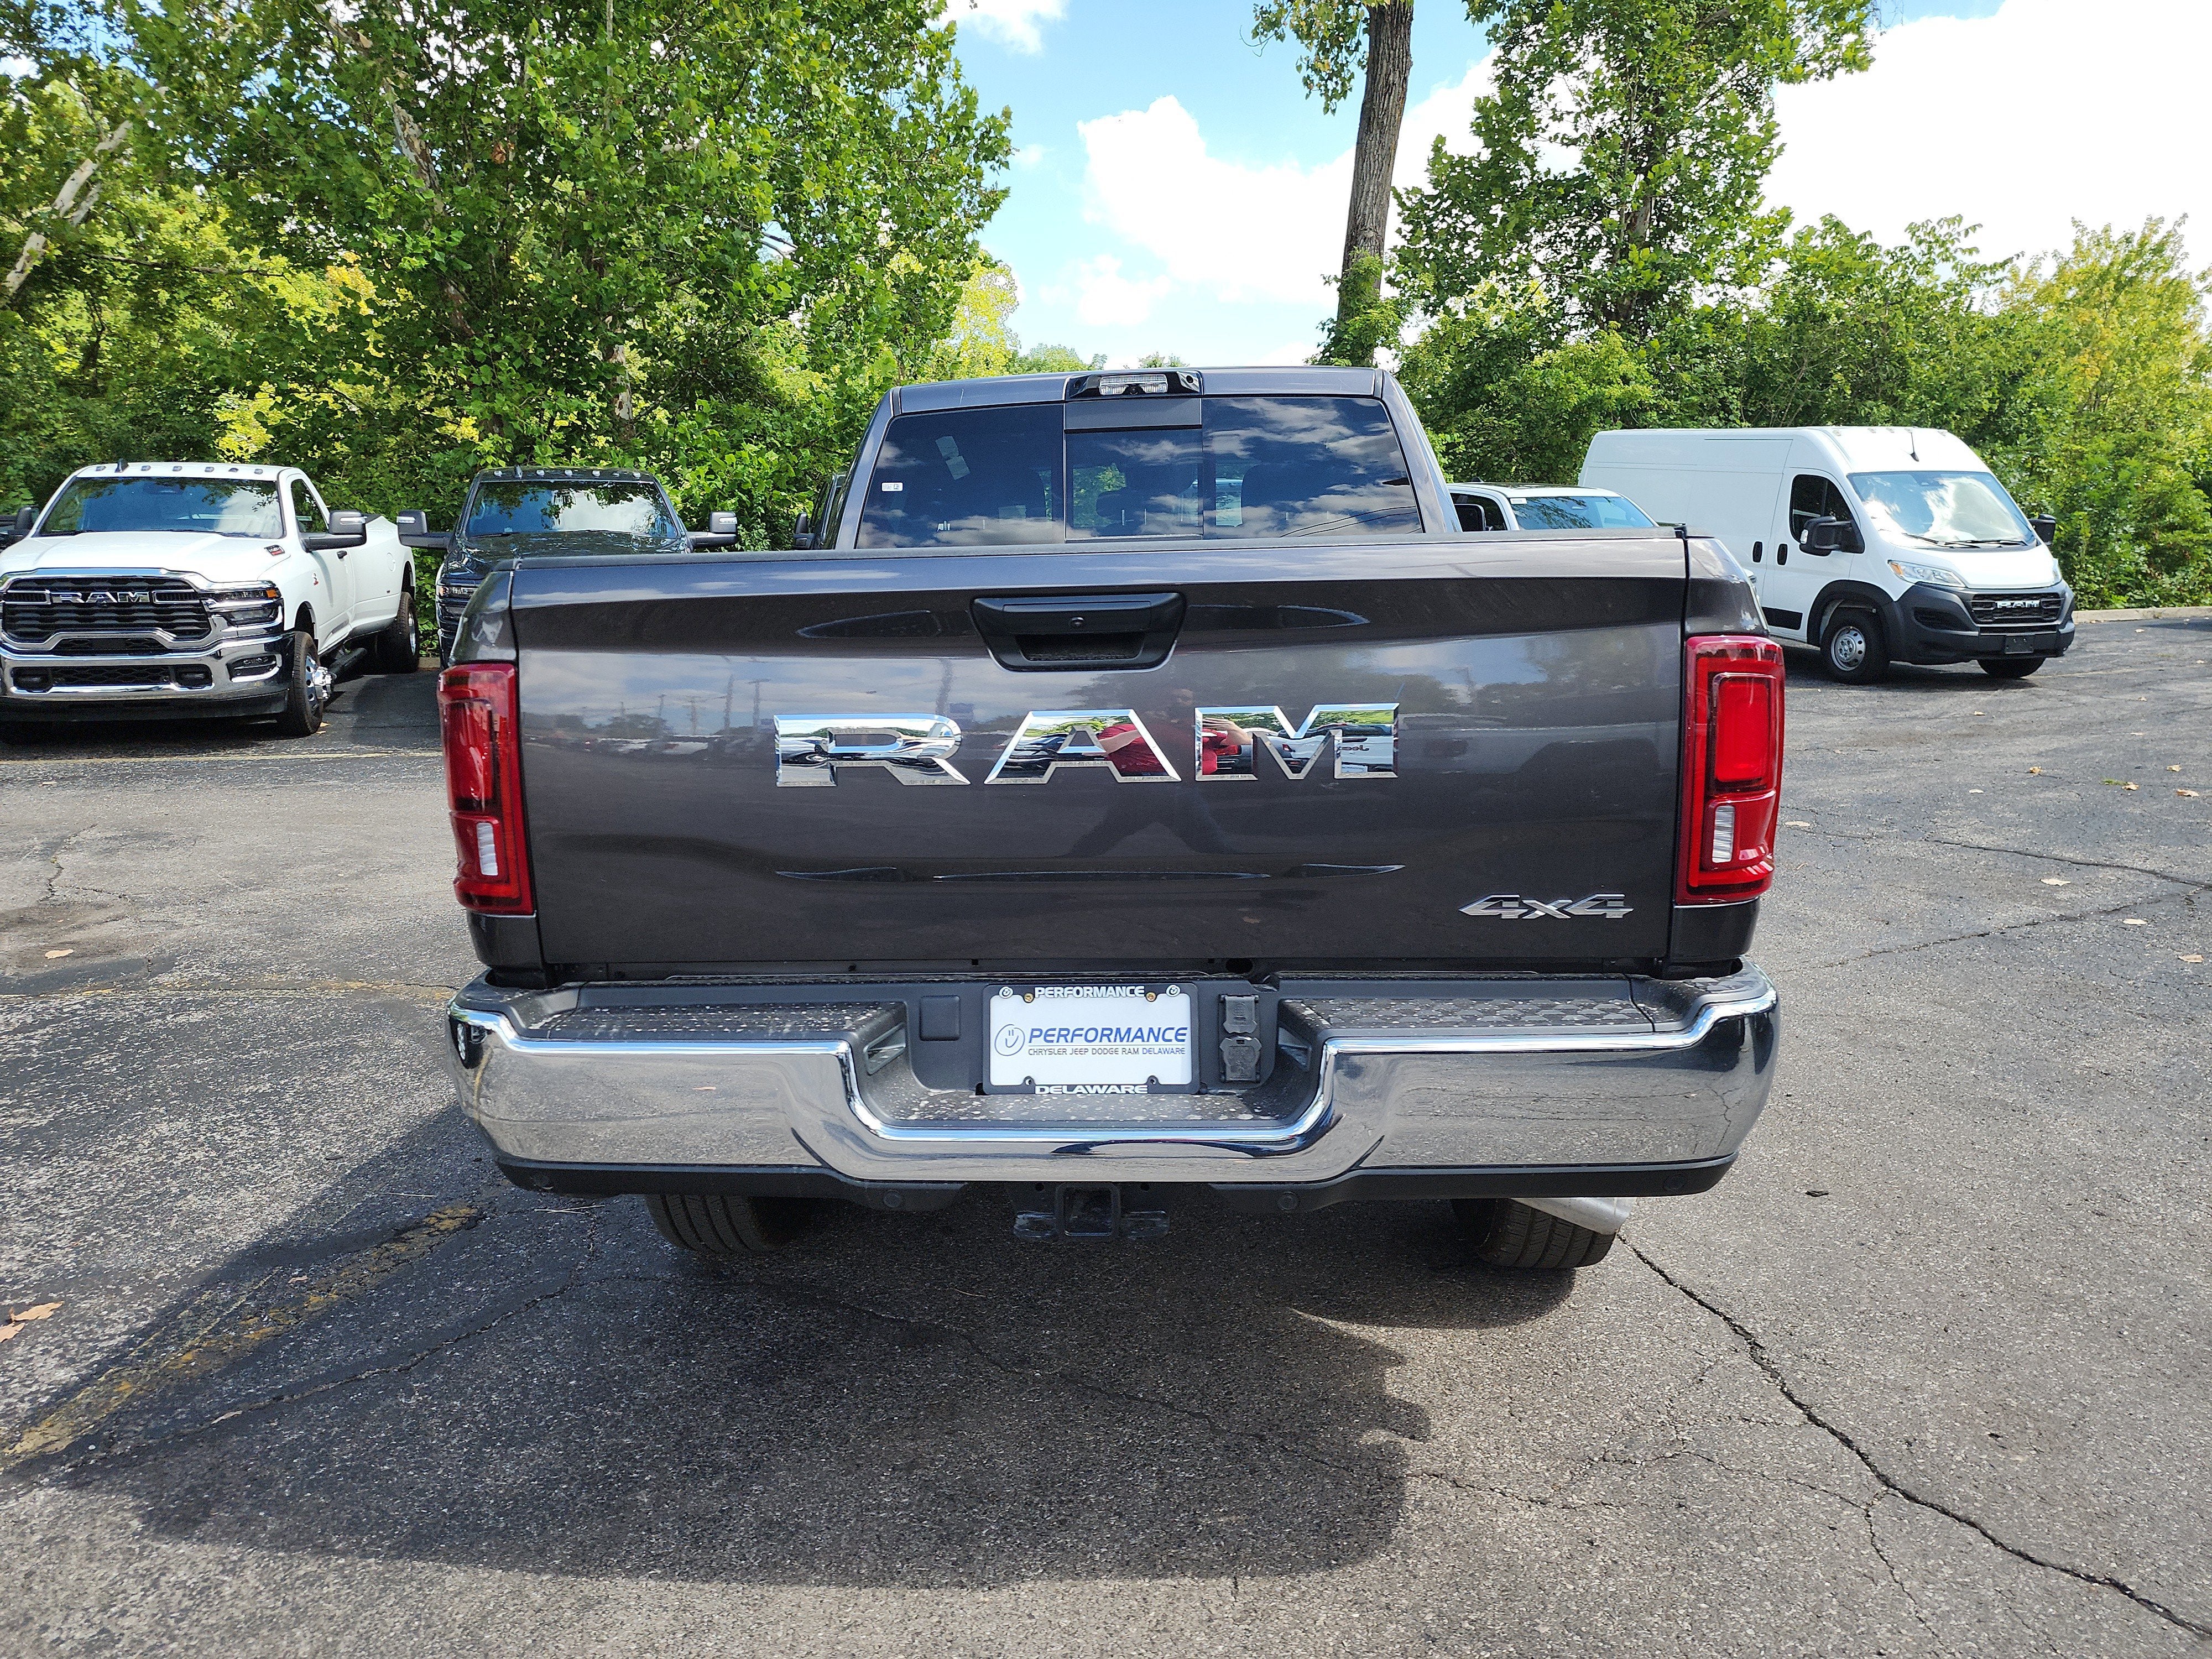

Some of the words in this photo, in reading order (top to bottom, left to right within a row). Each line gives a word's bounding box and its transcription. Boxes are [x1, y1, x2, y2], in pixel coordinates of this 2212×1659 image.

[51, 591, 150, 603] RAM
[1996, 600, 2040, 609] RAM
[774, 702, 1400, 787] RAM
[1458, 894, 1634, 919] 4x4
[1034, 986, 1145, 999] PERFORMANCE
[1028, 1027, 1188, 1044] PERFORMANCE
[1035, 1085, 1148, 1095] DELAWARE
